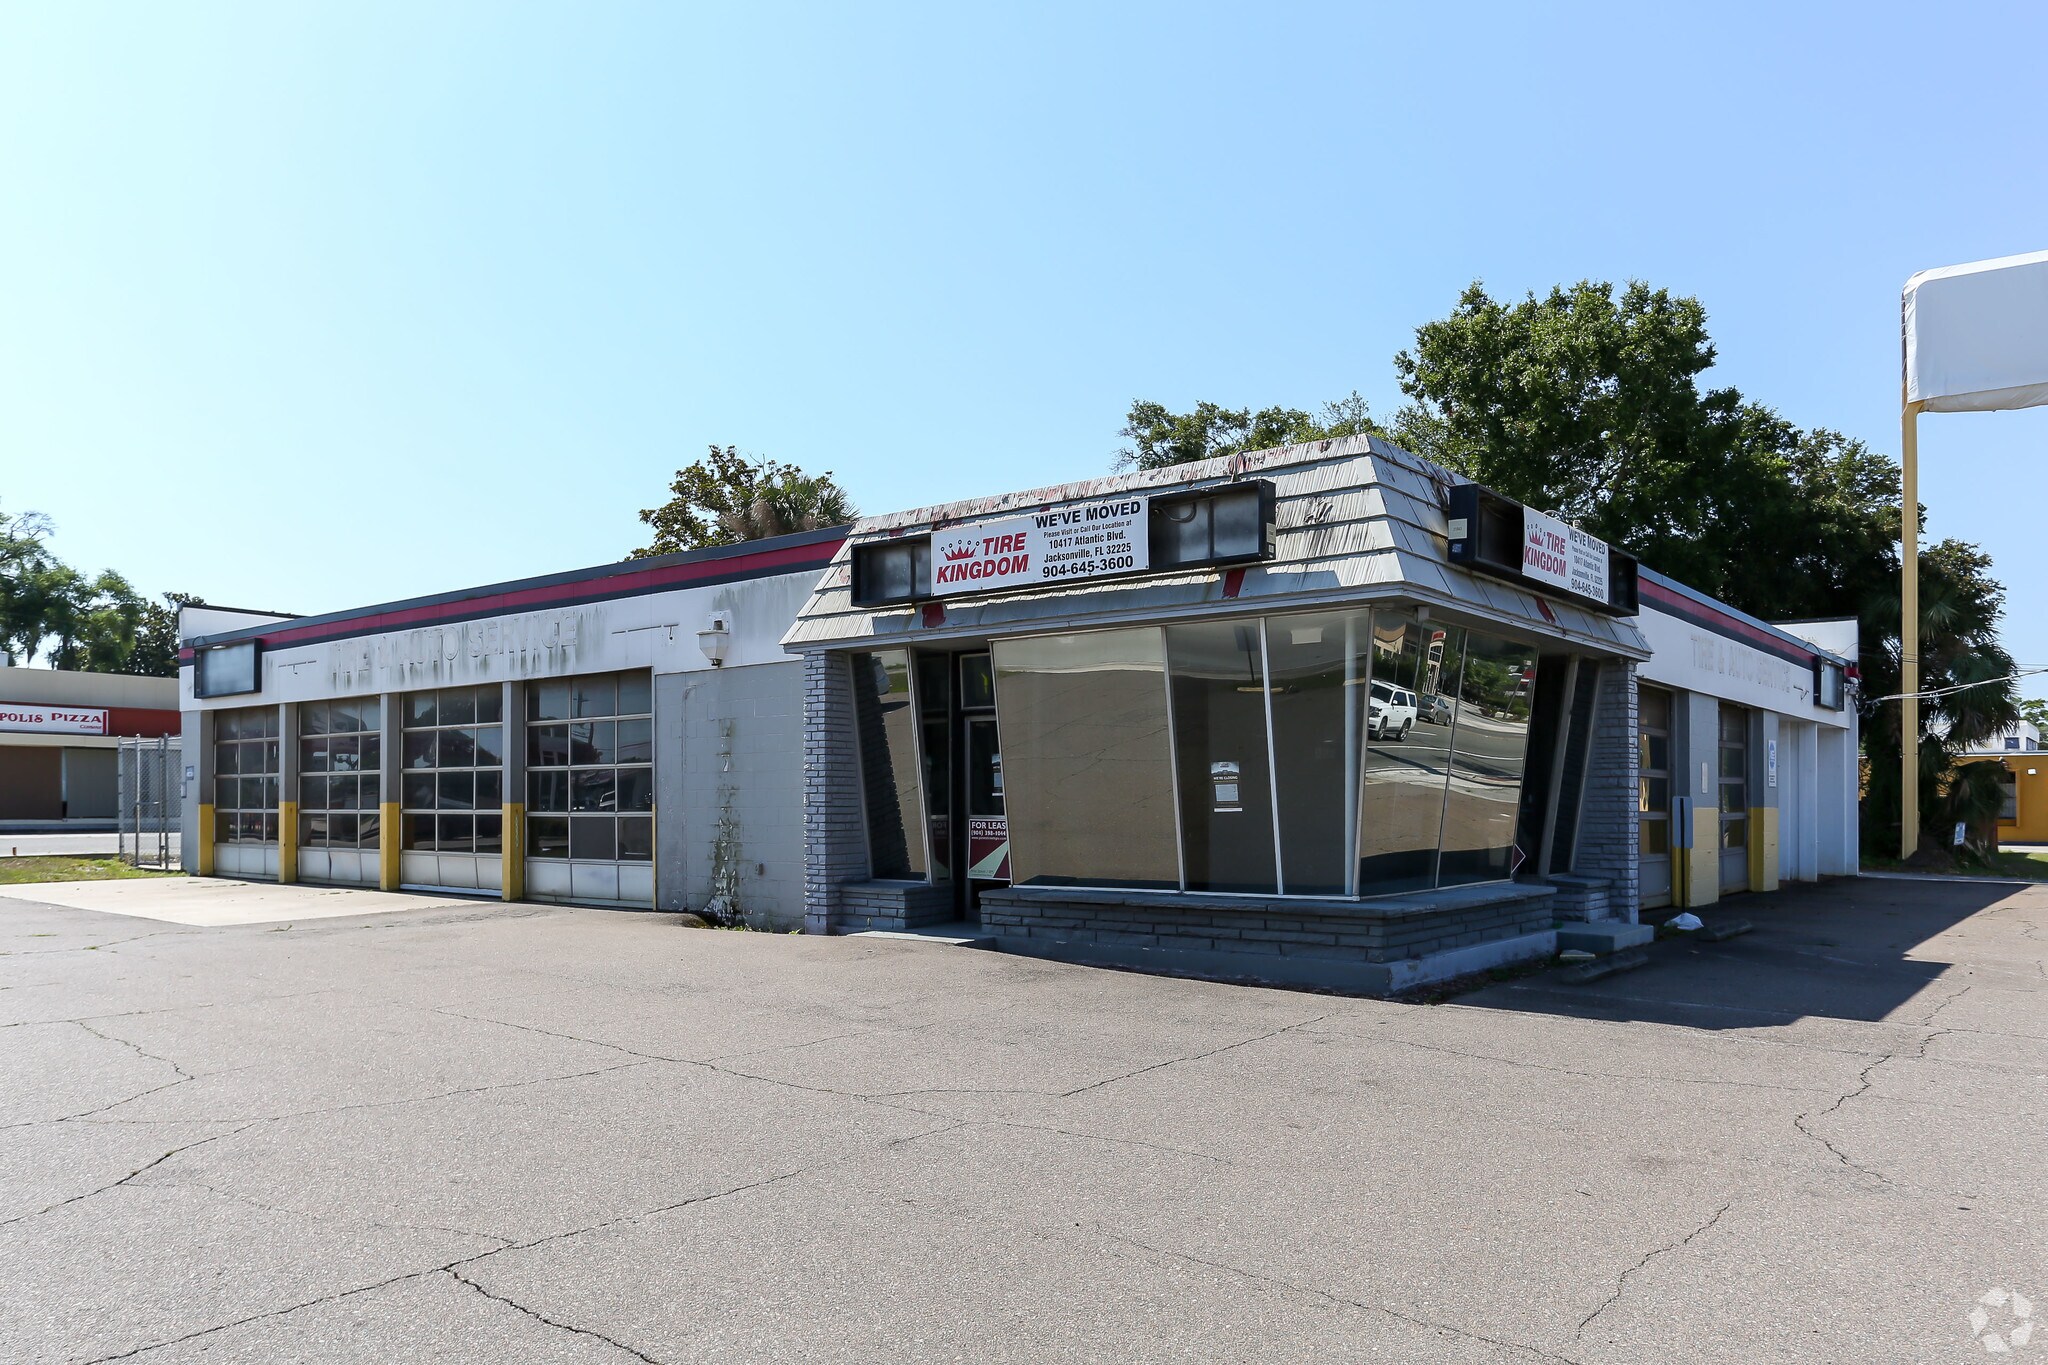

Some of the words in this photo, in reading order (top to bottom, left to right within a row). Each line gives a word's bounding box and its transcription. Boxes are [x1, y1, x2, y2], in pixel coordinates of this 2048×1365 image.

[1035, 510, 1081, 529] WE'VE
[1086, 501, 1141, 521] MOVED
[1043, 530, 1060, 539] Please
[1102, 520, 1125, 530] Location
[1049, 537, 1072, 549] 10417
[1075, 534, 1105, 546] Atlantic
[1107, 530, 1126, 541] Blvd.
[982, 532, 1027, 556] TIRE
[1043, 549, 1093, 563] Jacksonville,
[1095, 546, 1104, 557] FL
[1106, 542, 1131, 555] 32225
[1546, 532, 1566, 556] TIRE
[1587, 535, 1606, 555] MOVED
[936, 554, 1030, 584] KINGDOM
[1042, 555, 1134, 578] 904-645-3600
[1524, 545, 1567, 577] KINGDOM
[1571, 578, 1604, 600] 904-645-3600
[51, 713, 102, 724] PIZZA
